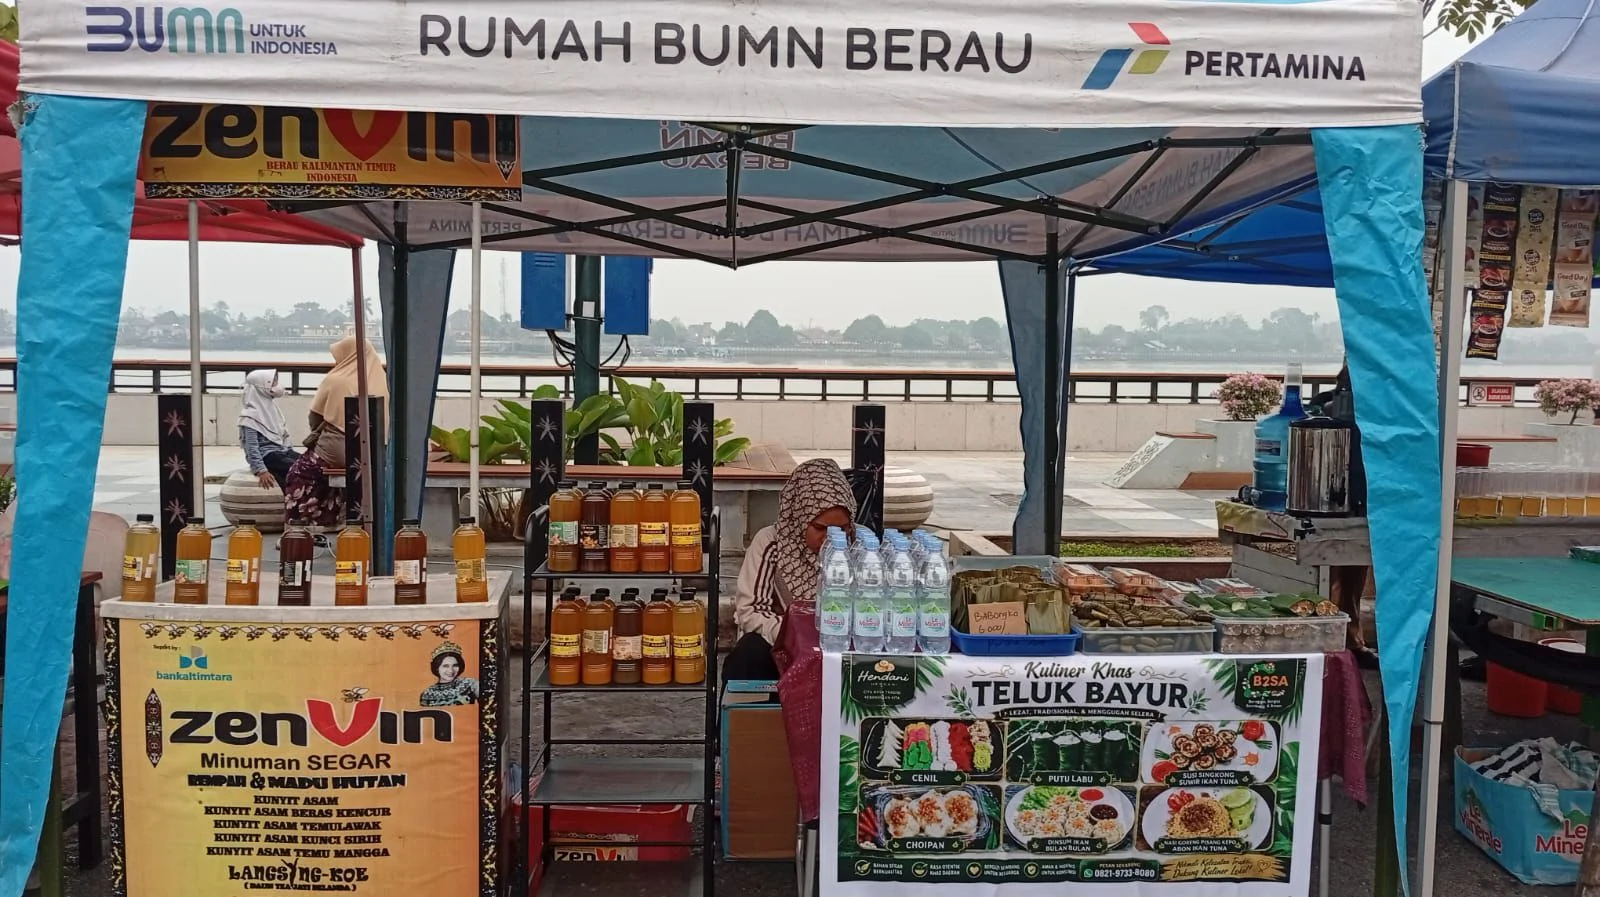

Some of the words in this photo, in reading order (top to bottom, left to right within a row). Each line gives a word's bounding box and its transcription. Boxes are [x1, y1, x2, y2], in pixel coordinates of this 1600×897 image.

[250, 23, 306, 38] UNTUK
[250, 39, 338, 56] INDONESIA
[419, 14, 631, 63] RUMAH
[654, 22, 824, 70] BUMN
[846, 27, 1032, 74] BERAU
[1184, 50, 1366, 82] PERTAMINA
[266, 160, 300, 171] BERAU
[301, 160, 363, 172] KALIMANTAN
[364, 161, 397, 173] TIMUR
[306, 172, 358, 182] INDONESIA
[156, 671, 233, 681] bankaltimtara
[1025, 661, 1087, 679] Kuliner
[1091, 661, 1135, 679] Khas
[857, 670, 910, 683] Hendani
[1253, 675, 1289, 687] B2SA
[972, 681, 1076, 707] TELUK
[1085, 682, 1188, 708] BAYUR
[201, 753, 300, 770] Minuman
[307, 753, 391, 770] SEGAR
[187, 774, 247, 787] REMPAH
[249, 771, 266, 790] &
[268, 776, 329, 790] MADU
[332, 774, 407, 789] HUTAN
[911, 774, 938, 783] CENIL
[1048, 775, 1070, 783] PUTU
[1071, 775, 1094, 783] LABU
[253, 795, 300, 806] KUNYIT
[303, 796, 339, 806] ASAM
[204, 806, 251, 816] KUNYIT
[254, 807, 288, 817] ASAM
[291, 808, 333, 818] BERAS
[336, 807, 392, 817] KENCUR
[213, 820, 261, 830] KUNYIT
[263, 820, 297, 830] ASAM
[300, 821, 382, 831] TEMULAWAK
[1564, 819, 1587, 839] Le
[214, 833, 261, 843] KUNYIT
[264, 834, 298, 844] ASAM
[301, 835, 341, 845] KUNCI
[344, 834, 382, 844] SIRIH
[905, 841, 945, 849] CHOIPAN
[1536, 835, 1585, 854] Mine
[206, 846, 254, 857] KUNYIT
[256, 847, 291, 857] ASAM
[294, 848, 330, 858] TEMU
[333, 847, 391, 858] MANGGA
[1094, 868, 1155, 877] 0821-9733-8080
